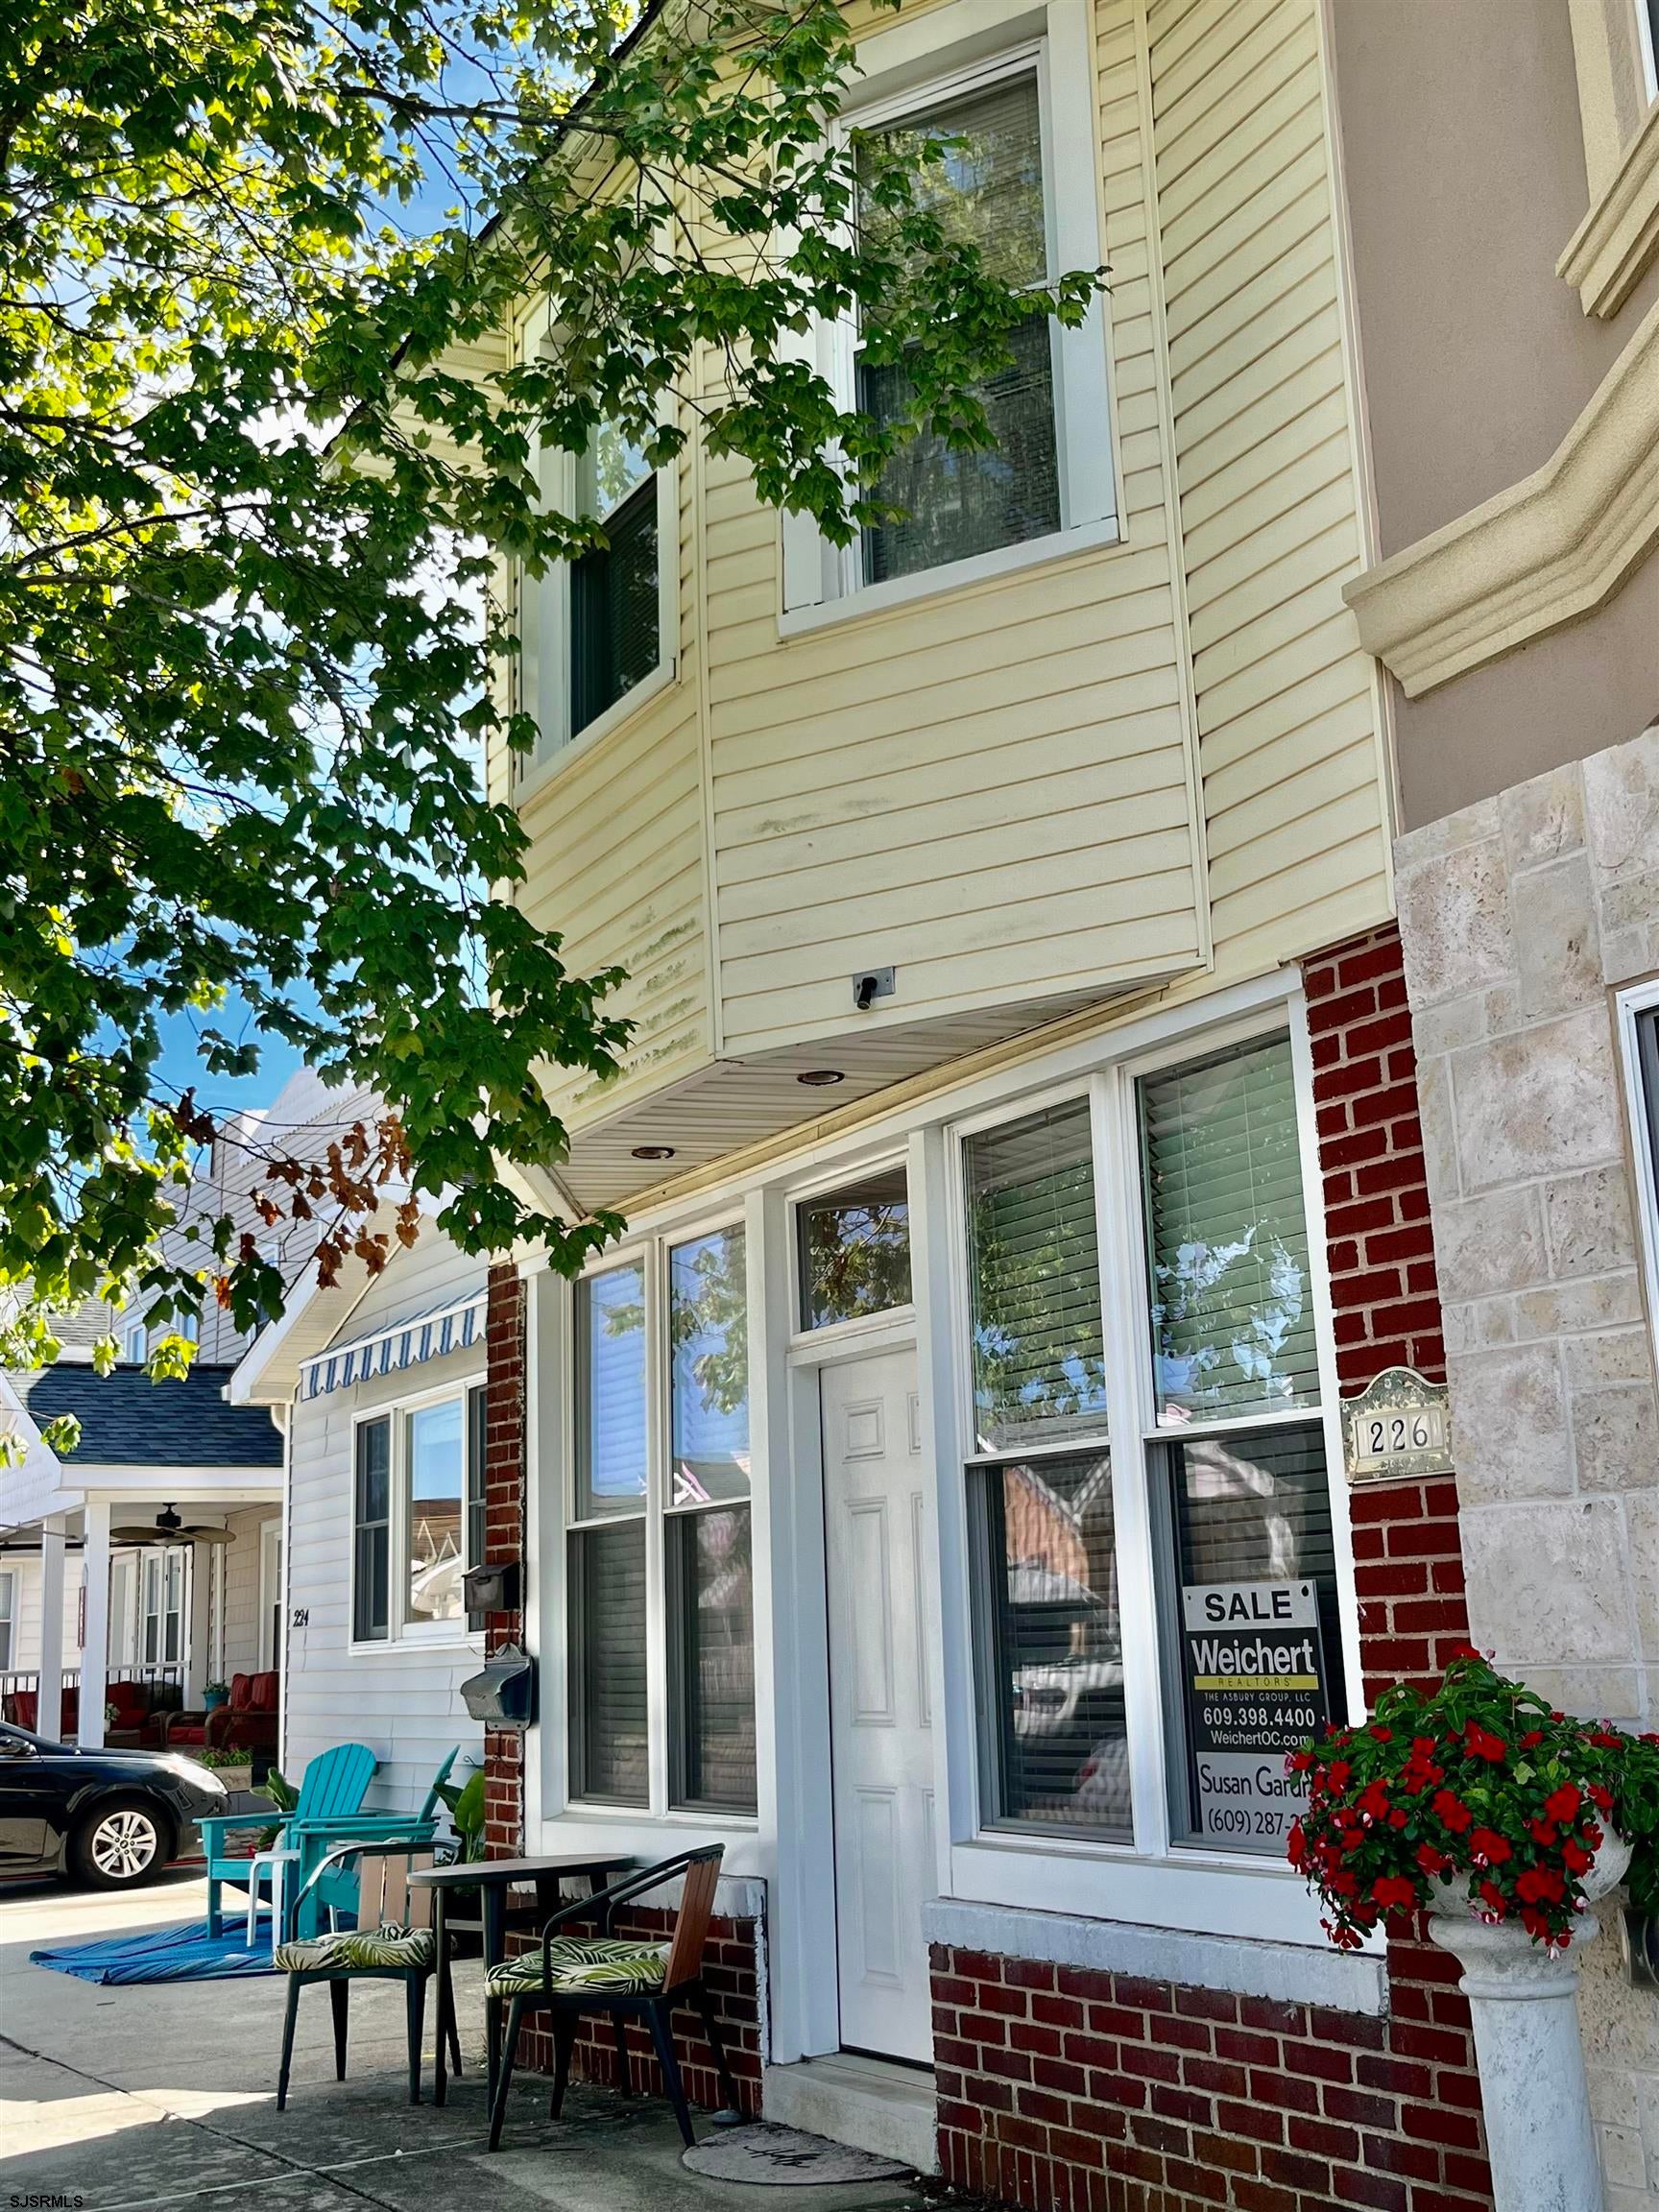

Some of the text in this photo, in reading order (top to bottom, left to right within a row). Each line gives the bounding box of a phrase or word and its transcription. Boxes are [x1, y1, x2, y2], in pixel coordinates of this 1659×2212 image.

[1370, 1416, 1429, 1453] 226
[1205, 1590, 1292, 1623] SALE
[1190, 1638, 1315, 1674] Weichert
[1204, 1693, 1219, 1702] THE
[1222, 1693, 1255, 1702] ASBURY
[1295, 1693, 1311, 1702] LLC
[1203, 1707, 1315, 1726] 609.398.4400
[1200, 1764, 1252, 1795] Susan
[1208, 1808, 1251, 1836] (609)
